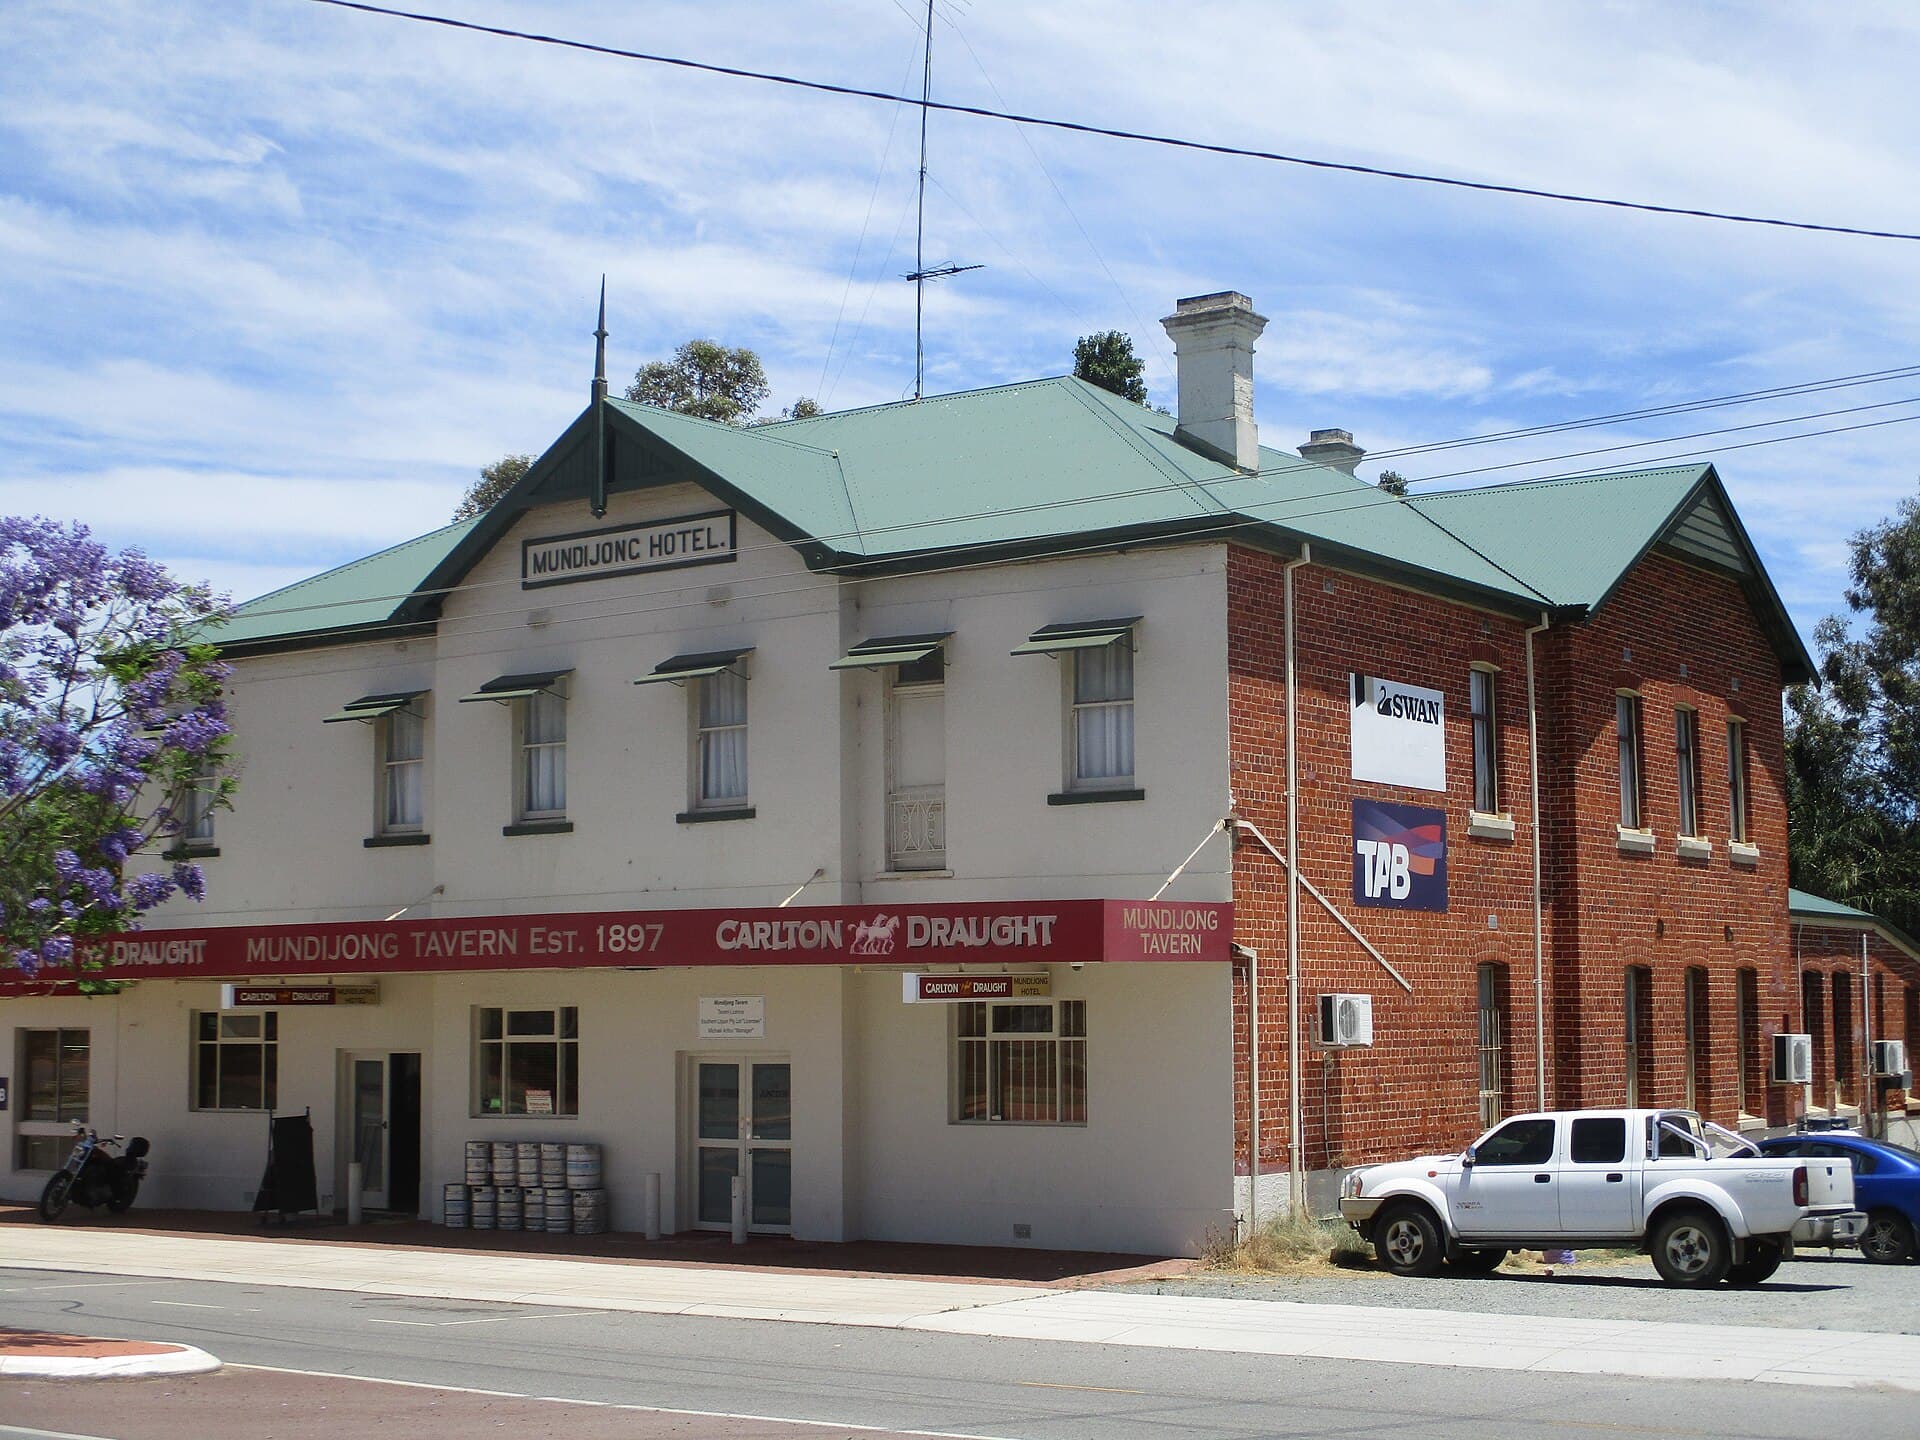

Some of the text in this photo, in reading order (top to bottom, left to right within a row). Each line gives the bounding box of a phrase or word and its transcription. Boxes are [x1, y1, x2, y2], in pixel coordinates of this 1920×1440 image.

[650, 527, 726, 557] HOTEL.
[1392, 694, 1440, 725] SWAN
[1357, 839, 1411, 900] TAB
[1123, 908, 1218, 930] MUNDIJONG
[246, 932, 399, 962] MUNDIJONG
[410, 928, 517, 958] TAVERN
[597, 924, 664, 952] 1897
[716, 915, 1056, 950] CARLTON DRAUGHT
[1140, 933, 1202, 954] TAVERN
[113, 940, 207, 966] DRAUGHT
[925, 982, 1008, 994] CARLTON DRAUGHT
[1014, 977, 1048, 985] MUNDIJONG
[1021, 987, 1040, 996] HOTEL
[240, 992, 276, 1001] CARLTON
[292, 992, 330, 1001] DRAUGHT
